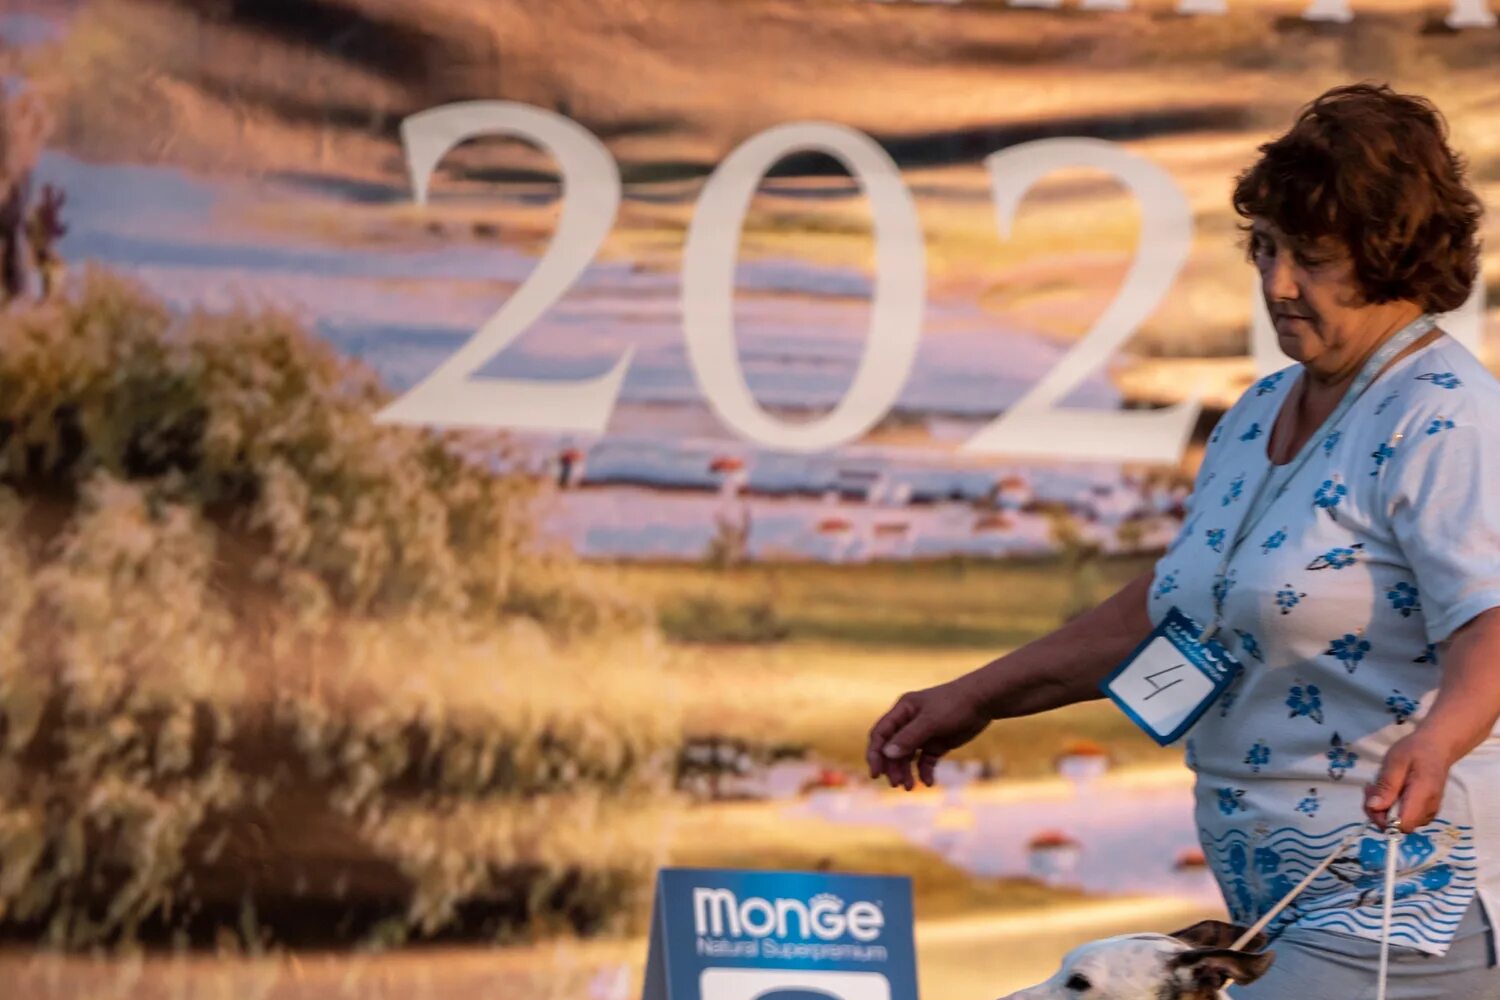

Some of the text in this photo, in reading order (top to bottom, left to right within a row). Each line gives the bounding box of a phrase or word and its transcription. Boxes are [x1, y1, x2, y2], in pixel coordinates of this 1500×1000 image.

[1143, 663, 1187, 701] 4
[696, 936, 888, 962] Natural Superpremium
